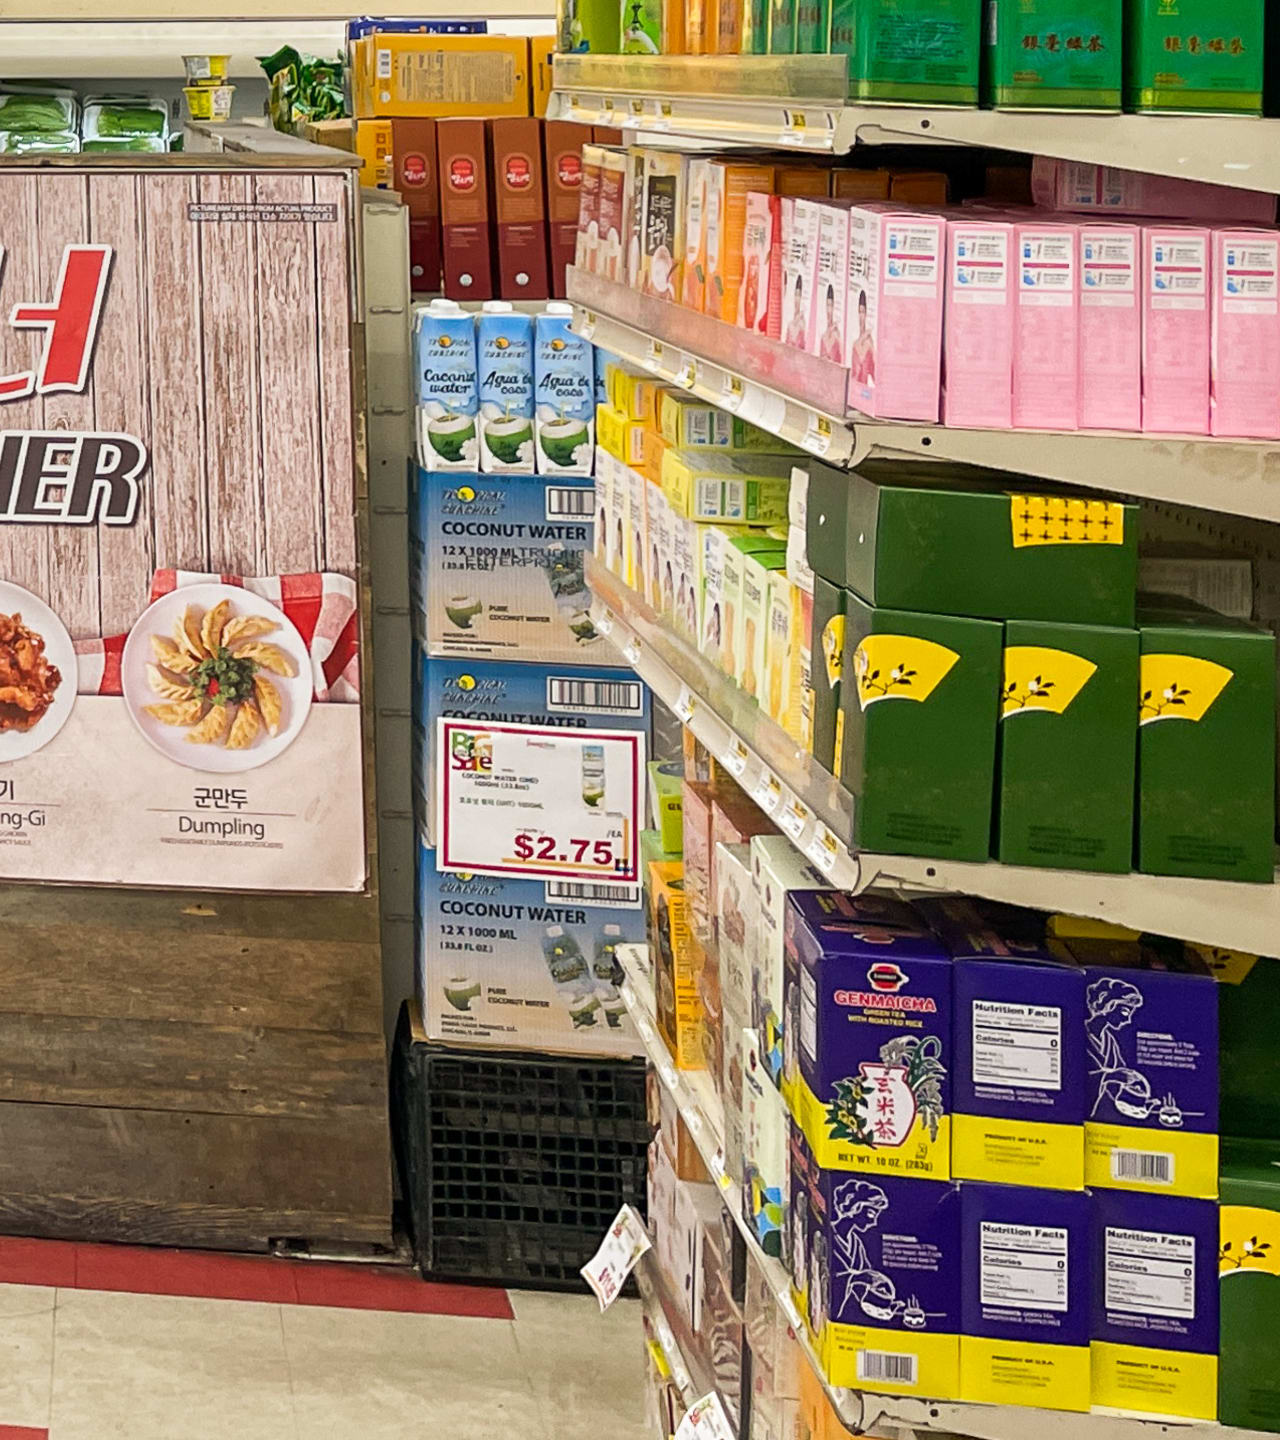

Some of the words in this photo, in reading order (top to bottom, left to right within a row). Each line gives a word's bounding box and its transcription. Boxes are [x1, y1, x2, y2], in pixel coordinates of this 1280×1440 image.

[424, 369, 475, 383] Coconut
[483, 371, 518, 388] Agua
[540, 373, 573, 390] Agua
[430, 383, 471, 394] water
[442, 521, 525, 538] COCONUT
[529, 525, 587, 540] WATER
[442, 546, 455, 555] 12
[458, 546, 466, 556] X
[470, 547, 498, 557] 1000
[193, 787, 248, 809] 군만두
[179, 816, 265, 839] Dumpling
[606, 829, 623, 839] /EA
[514, 833, 613, 865] $2.75
[440, 900, 524, 920] COCONUT
[528, 906, 587, 924] WATER
[440, 925, 454, 935] 12
[456, 926, 465, 936] X
[469, 927, 496, 938] 1000
[499, 928, 517, 940] ML
[834, 990, 937, 1013] GENMAICHA
[864, 1009, 890, 1018] GREEN
[975, 1003, 1025, 1015] Nutrition
[1028, 1004, 1058, 1018] Facts
[848, 1015, 867, 1023] WITH
[868, 1016, 904, 1026] ROASTED
[906, 1019, 923, 1028] RICE
[975, 1034, 1015, 1045] Calories
[1050, 1039, 1058, 1047] 0
[838, 1153, 854, 1163] NET
[876, 1156, 886, 1166] 10
[983, 1225, 1032, 1237] Nutrition
[1035, 1227, 1065, 1240] Facts
[1107, 1230, 1157, 1244] Nutrition
[1161, 1235, 1193, 1248] Facts
[983, 1255, 1022, 1266] Calories
[1058, 1260, 1065, 1269] 0
[1107, 1261, 1148, 1272] Calories
[1184, 1268, 1192, 1277] 0
